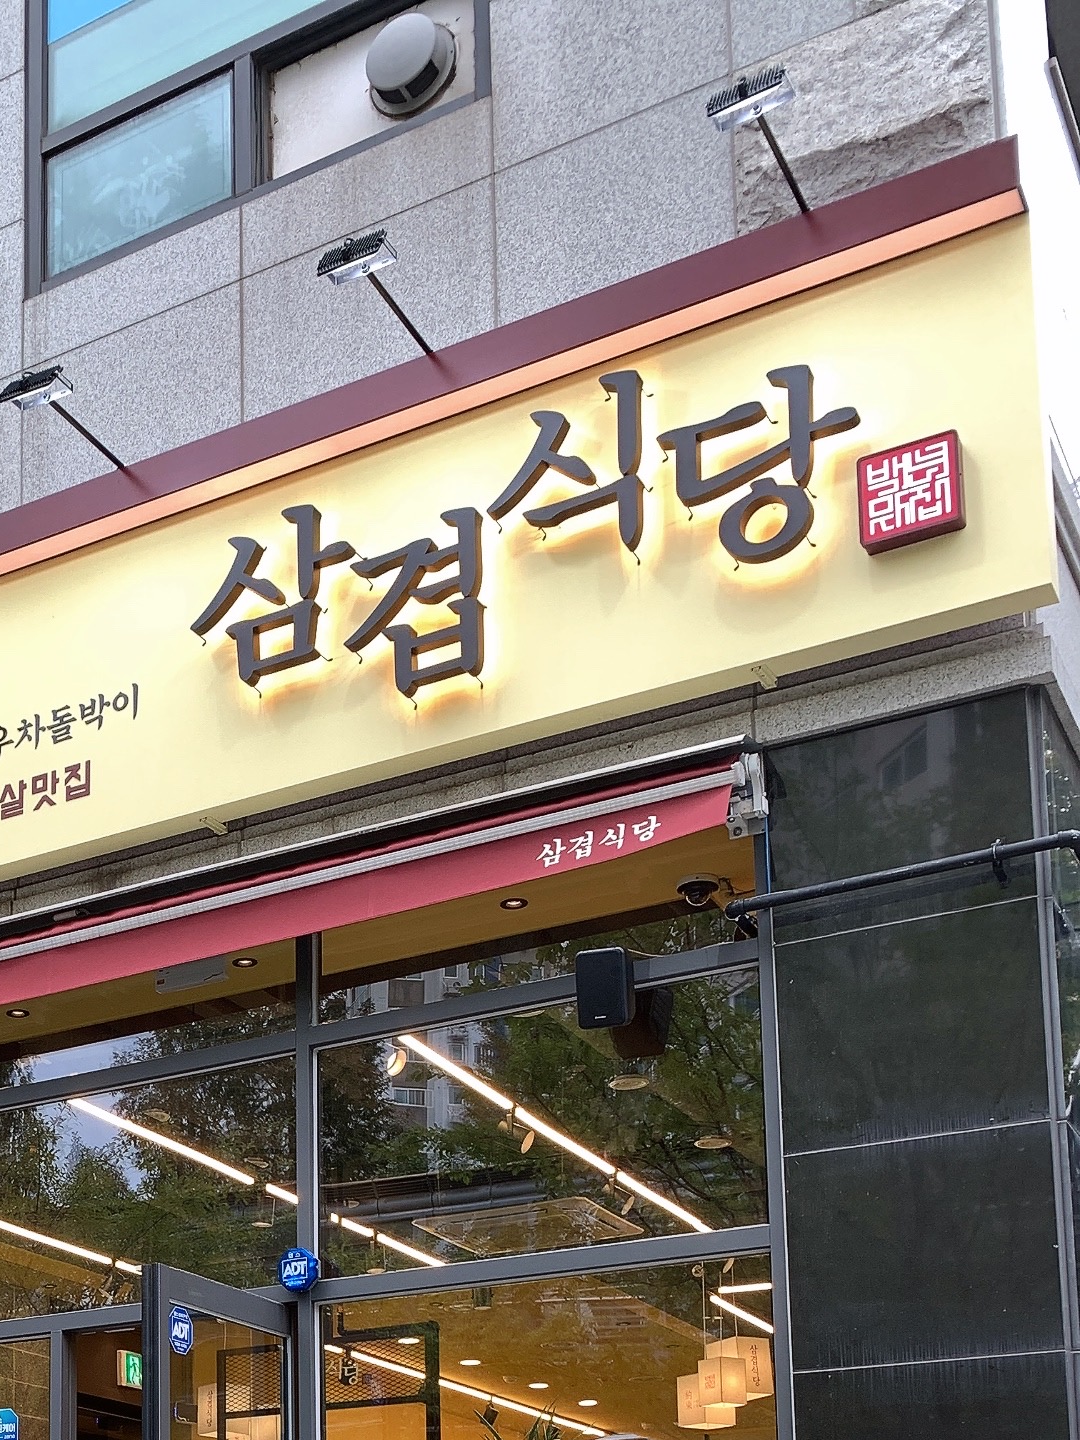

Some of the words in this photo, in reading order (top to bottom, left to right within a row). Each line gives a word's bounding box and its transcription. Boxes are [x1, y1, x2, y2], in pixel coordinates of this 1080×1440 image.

[191, 364, 860, 698] 삼겹식당
[536, 815, 661, 868] 삼겹식당
[283, 1260, 307, 1277] ADT
[172, 1321, 189, 1340] ADT
